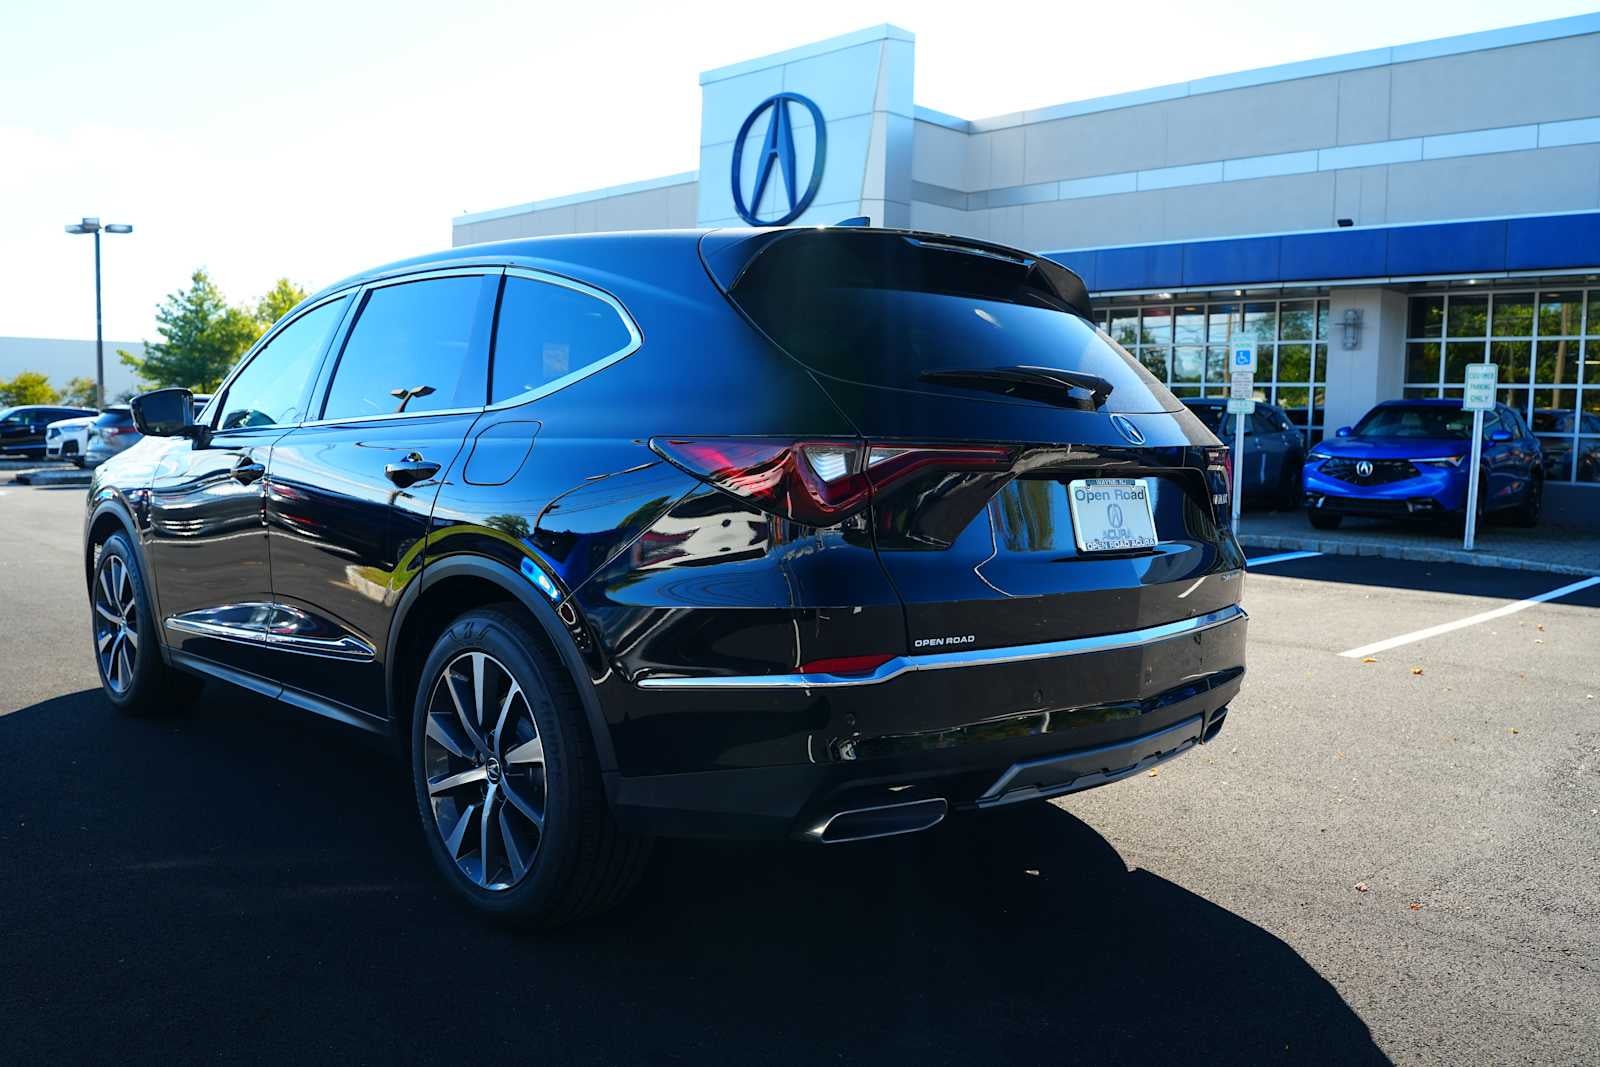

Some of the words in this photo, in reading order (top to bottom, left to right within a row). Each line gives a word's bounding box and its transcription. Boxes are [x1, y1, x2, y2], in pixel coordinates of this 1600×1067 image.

[1075, 489, 1110, 504] Open
[1115, 489, 1145, 500] Road
[1086, 541, 1108, 550] OPEN
[1109, 539, 1130, 549] ROAD
[1132, 537, 1155, 547] ACURA
[914, 638, 945, 647] OPEN
[945, 635, 975, 645] ROAD
